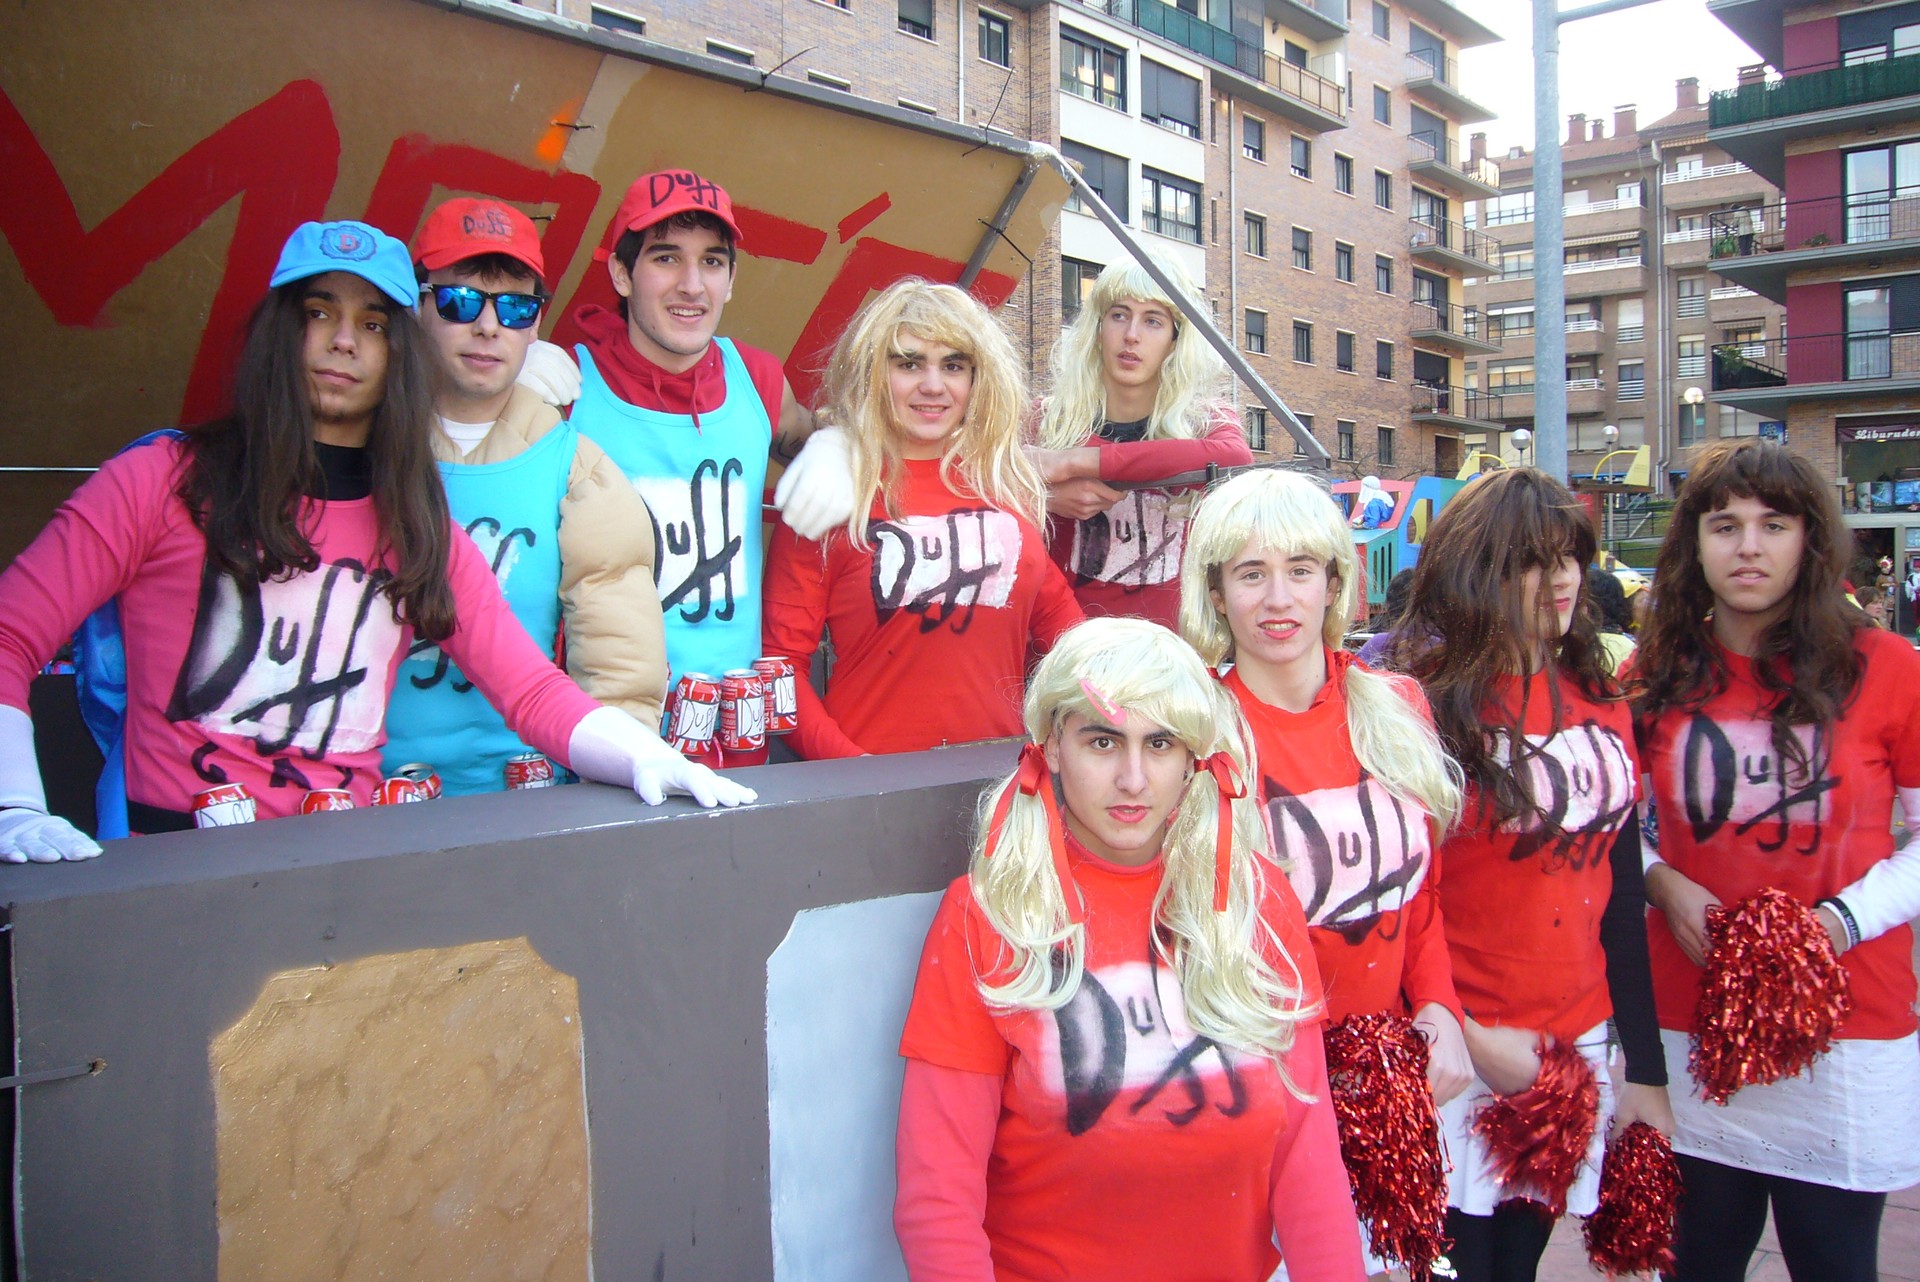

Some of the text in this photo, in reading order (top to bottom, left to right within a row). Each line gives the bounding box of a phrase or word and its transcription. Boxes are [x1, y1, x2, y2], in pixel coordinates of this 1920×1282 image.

[463, 211, 505, 235] Duff
[649, 172, 721, 210] Duff
[640, 457, 742, 624] uff
[867, 507, 1003, 635] Duff
[165, 556, 398, 761] Duff
[1265, 765, 1425, 946] Duff
[1684, 711, 1842, 856] Duff
